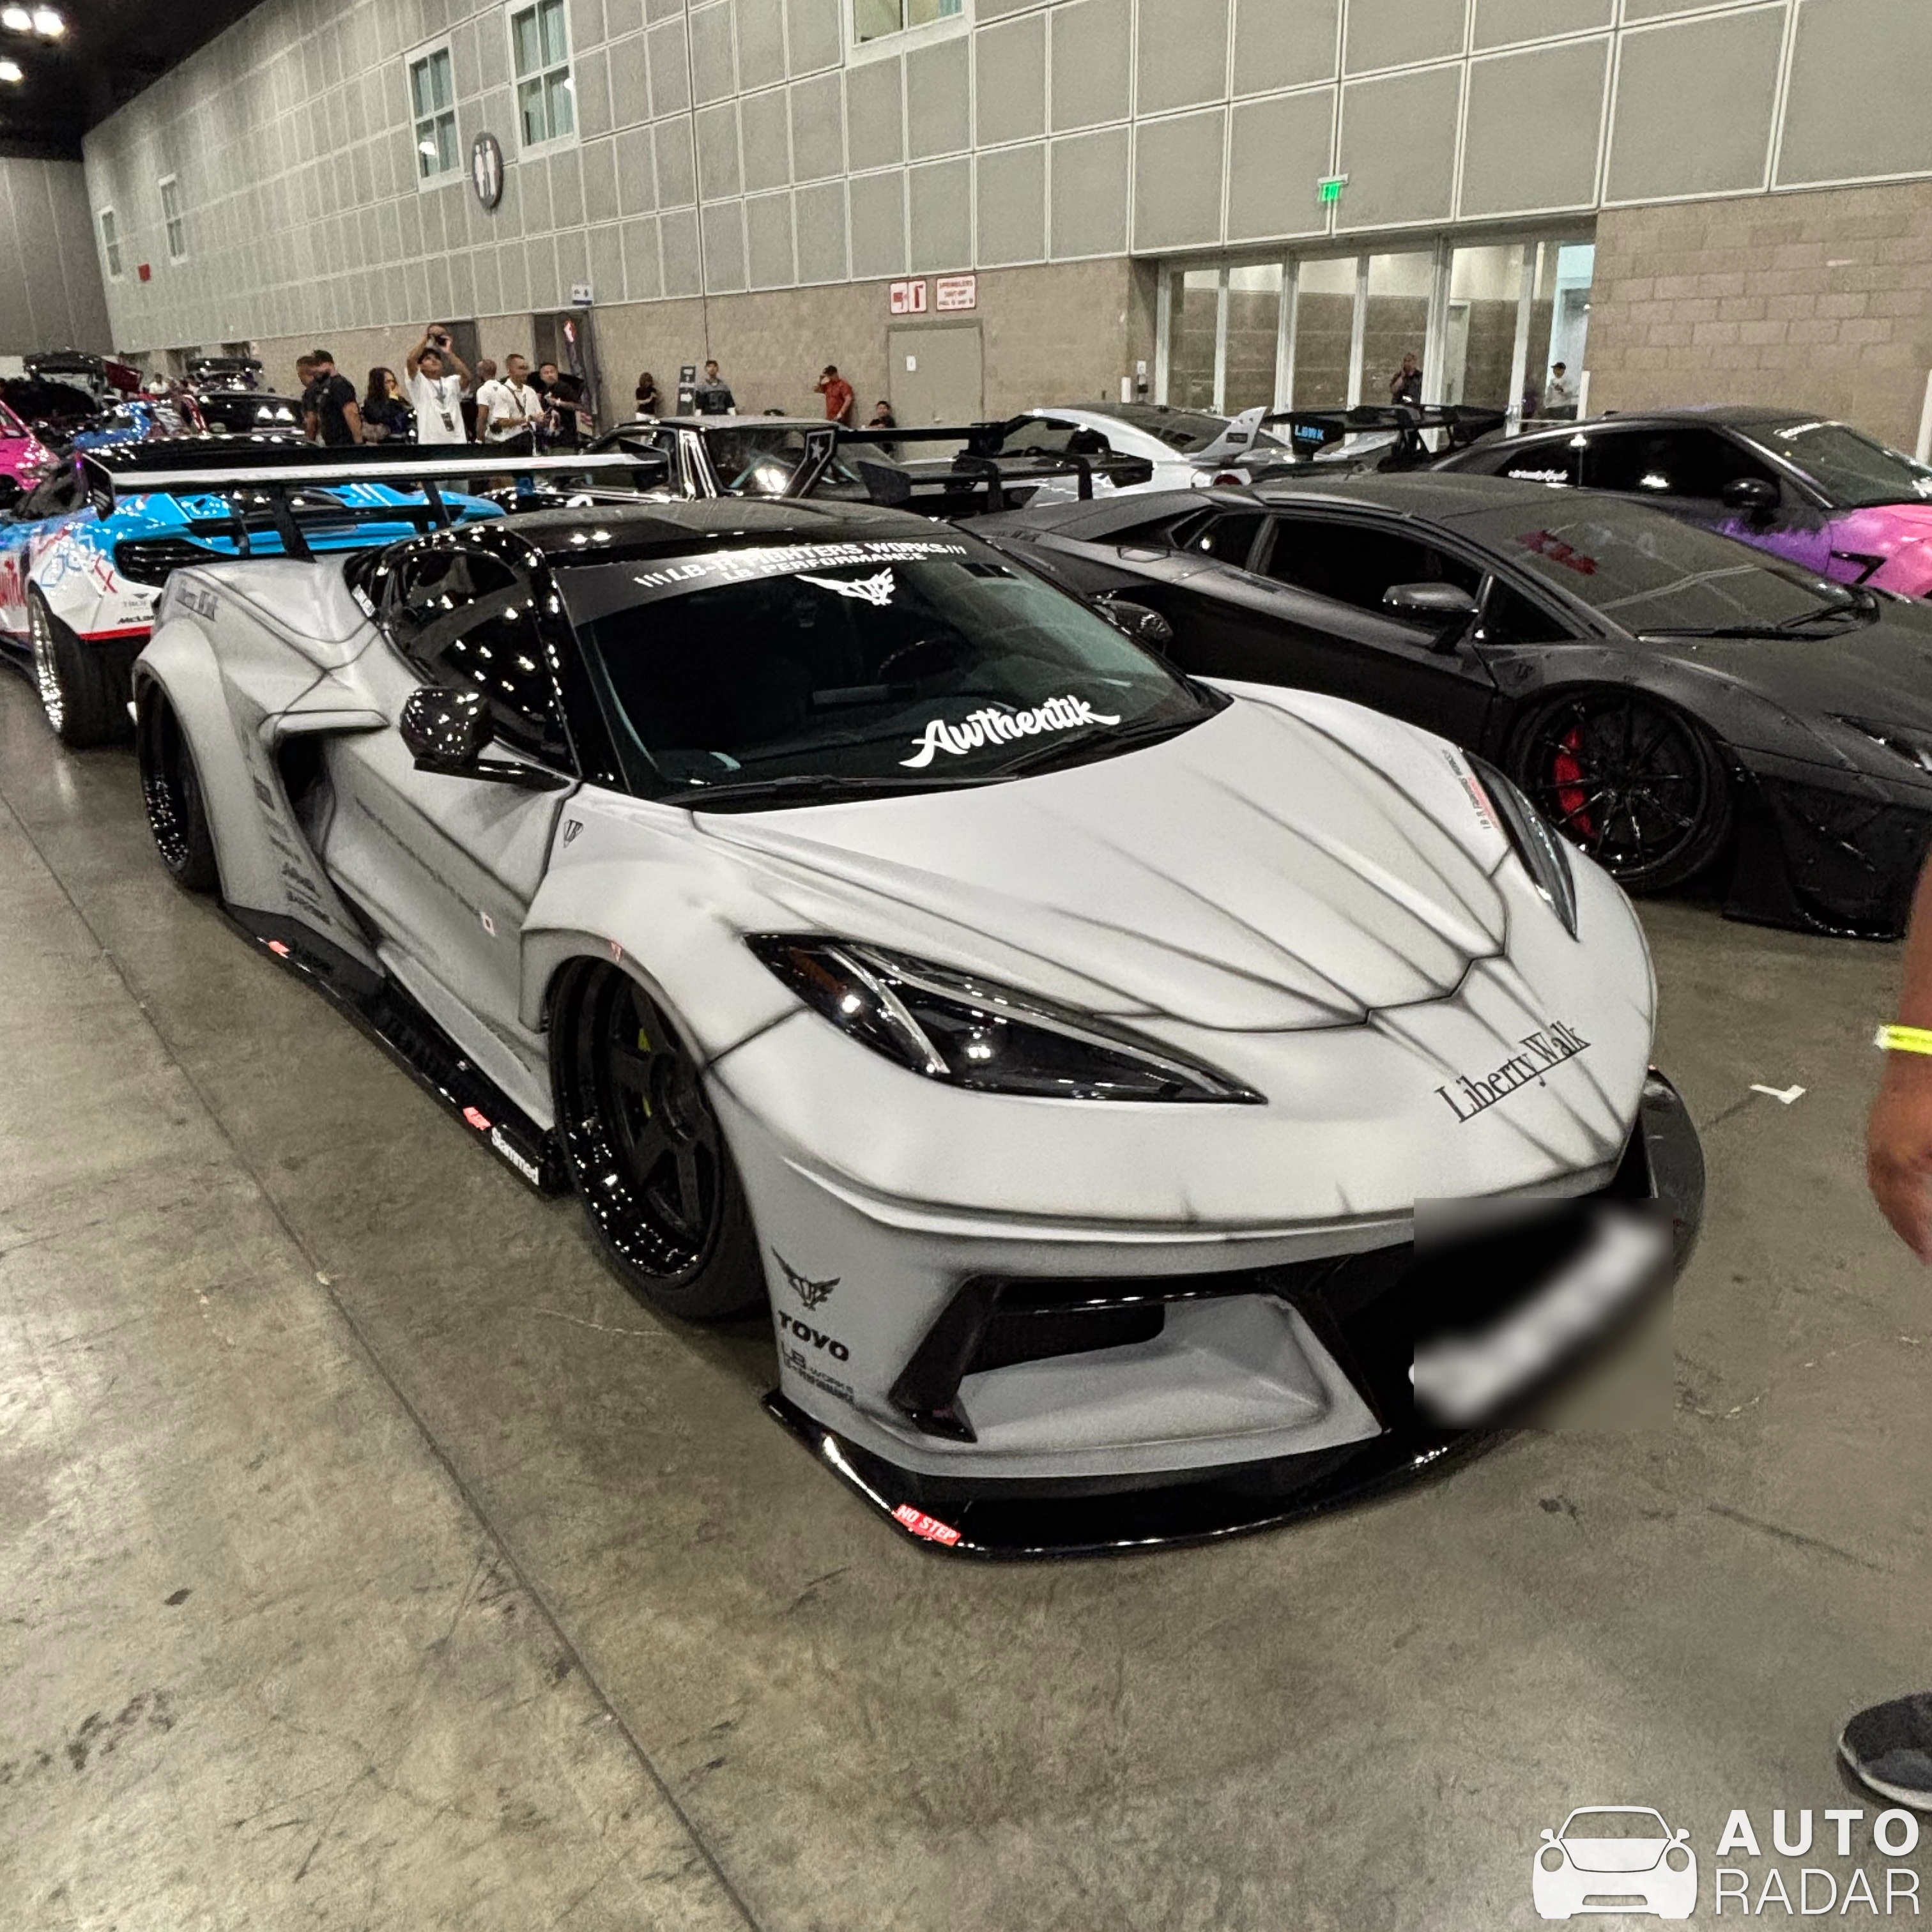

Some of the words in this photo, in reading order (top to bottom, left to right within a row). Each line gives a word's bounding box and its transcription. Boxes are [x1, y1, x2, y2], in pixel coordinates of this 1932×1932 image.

[721, 569, 755, 581] LB
[760, 553, 928, 574] PERFORMANCE
[742, 544, 864, 567] FIGHTERS
[1434, 1053, 1546, 1124] Liberty
[1517, 1020, 1591, 1066] Walk
[778, 1309, 849, 1361] TOYO
[896, 1505, 920, 1523] NO
[919, 1515, 958, 1540] STEP
